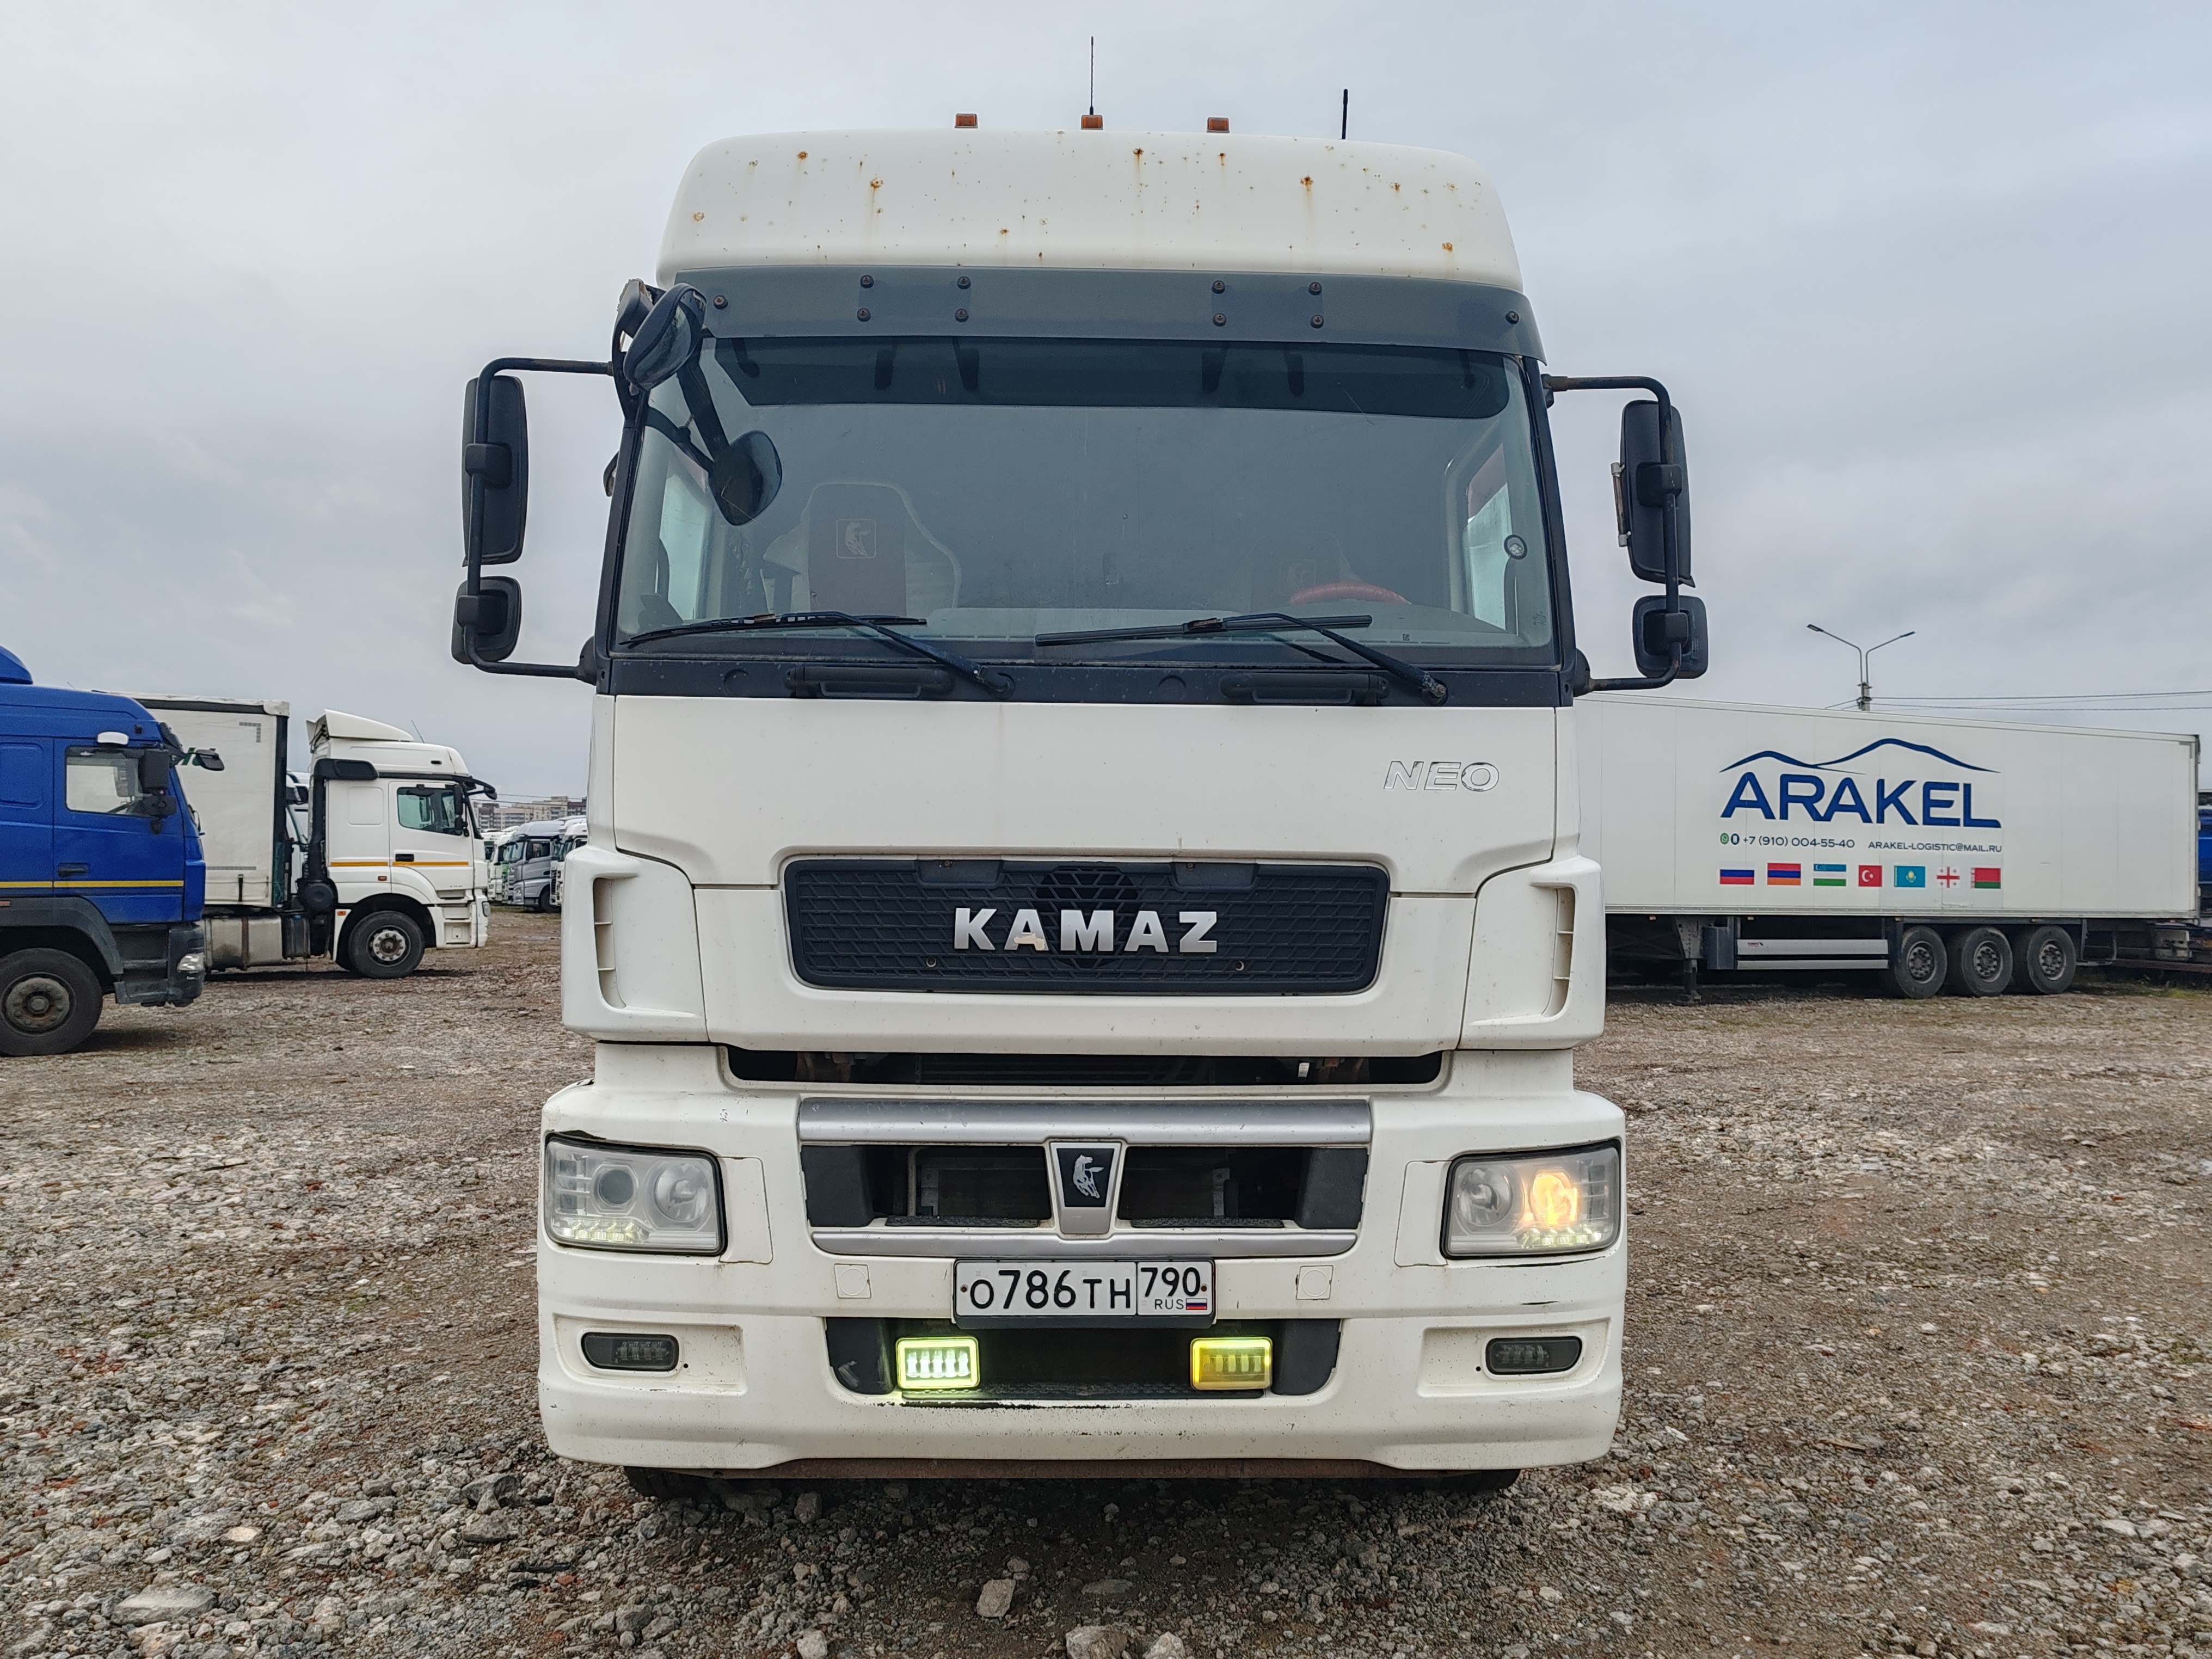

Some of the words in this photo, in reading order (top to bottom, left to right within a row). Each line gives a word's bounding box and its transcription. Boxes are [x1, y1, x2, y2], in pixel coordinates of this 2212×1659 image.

[1383, 760, 1500, 791] NEO
[1720, 772, 2002, 828] ARAKEL
[1743, 836, 1756, 845] +7
[1759, 835, 1788, 847] (910)
[1791, 837, 1855, 848] 004-55-40
[1868, 841, 2002, 852] ARAKEL-LOGISTIC@MAIL.RU
[954, 907, 1218, 954] KAMAZ
[1140, 1267, 1201, 1297] 790
[1154, 1299, 1184, 1310] RUS
